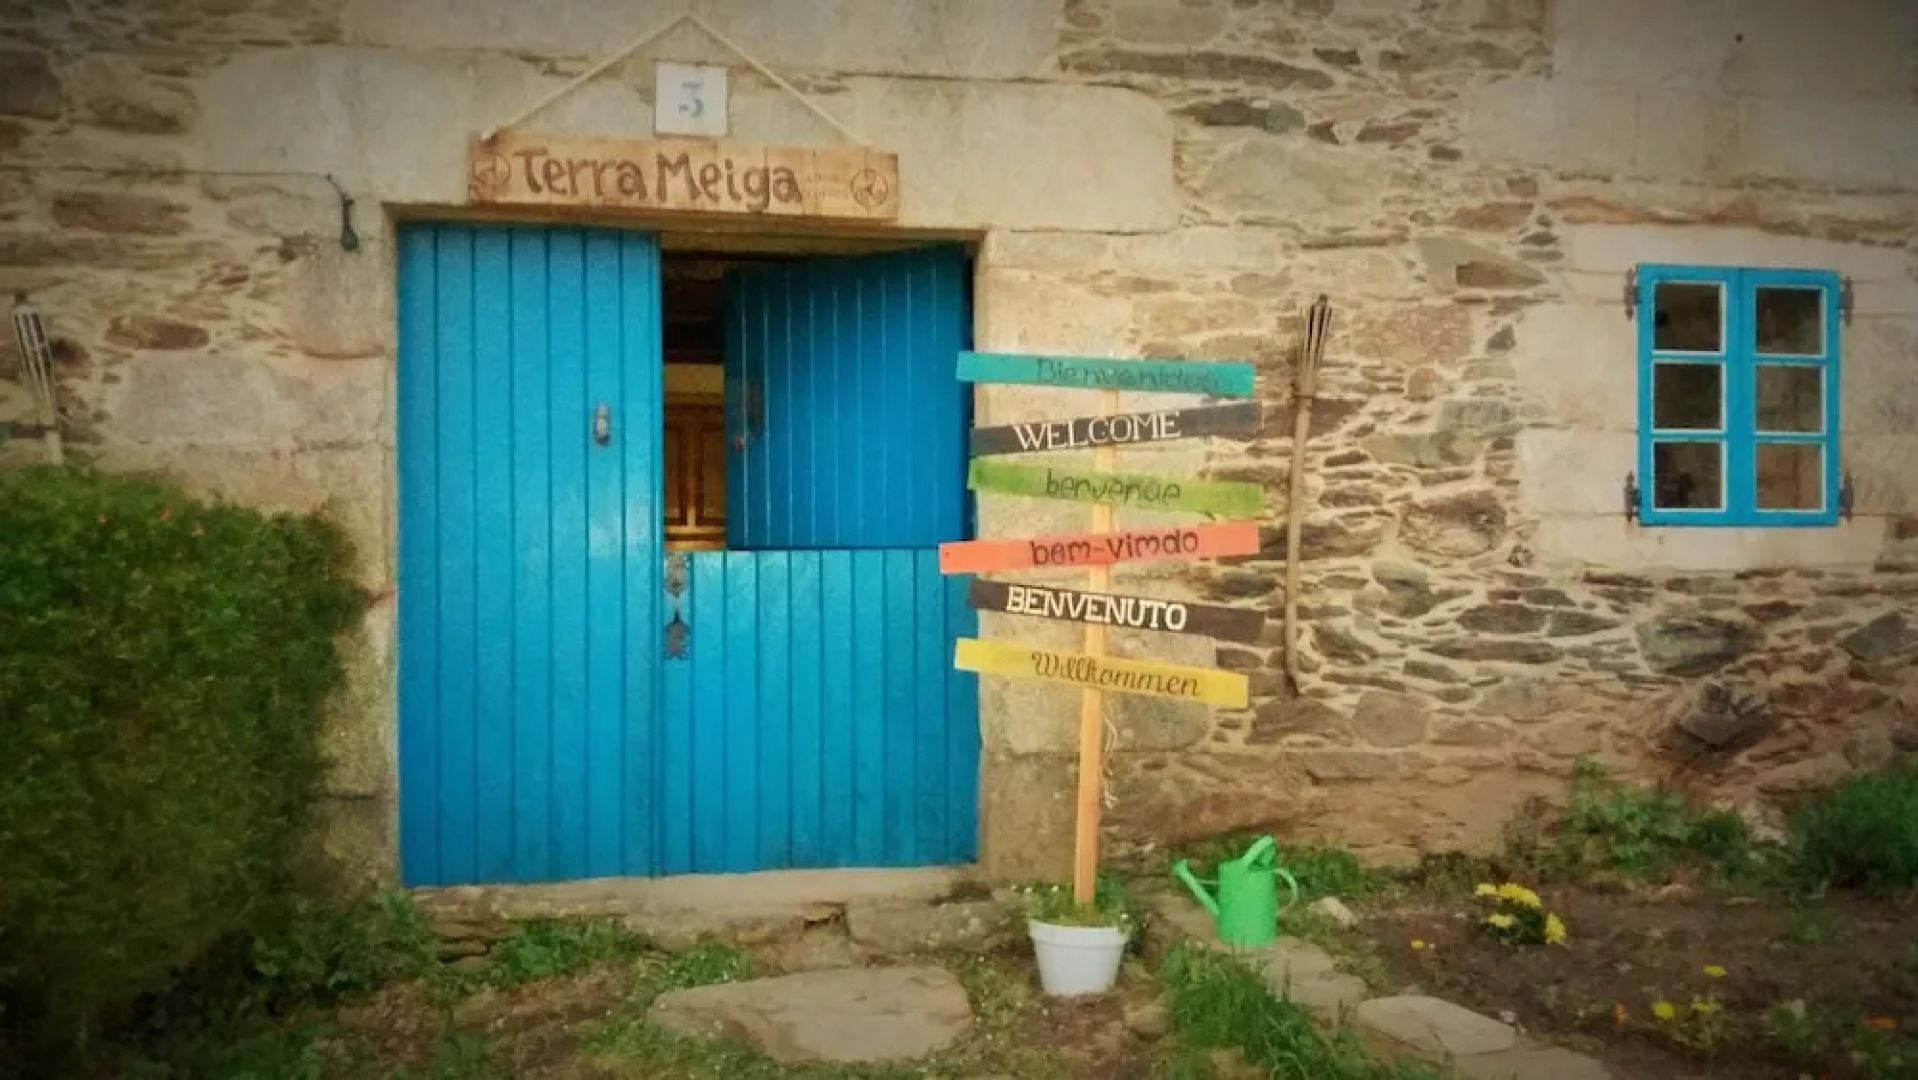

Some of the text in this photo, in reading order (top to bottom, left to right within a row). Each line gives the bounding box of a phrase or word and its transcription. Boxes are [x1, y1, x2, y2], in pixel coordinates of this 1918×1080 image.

[513, 147, 648, 200] Terra
[656, 152, 804, 212] Meiga
[1013, 411, 1182, 451] WELCOME
[1006, 586, 1188, 630] BENVENUTO
[1030, 651, 1201, 697] Willkommen
